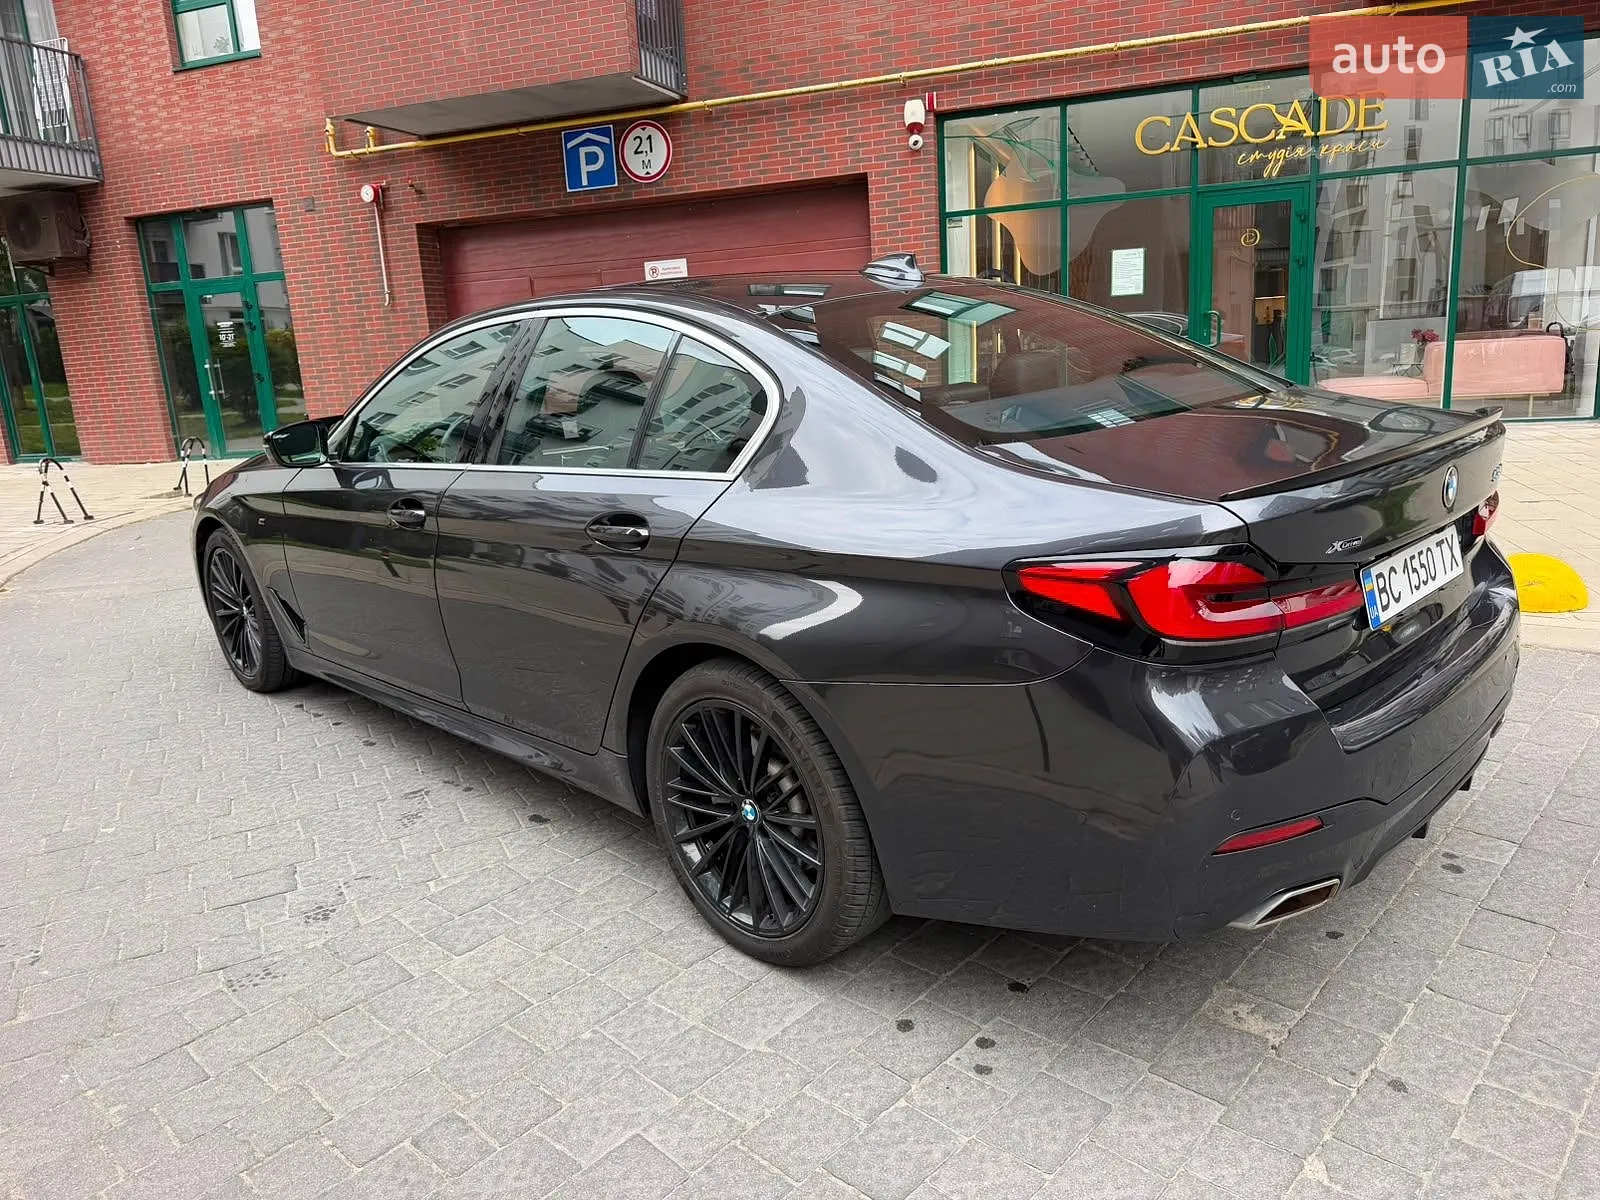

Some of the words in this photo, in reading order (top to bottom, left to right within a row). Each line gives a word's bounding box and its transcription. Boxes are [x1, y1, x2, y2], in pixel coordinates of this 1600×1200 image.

[1135, 90, 1388, 155] CASCADE
[579, 145, 605, 186] P
[633, 134, 653, 157] 2,1
[1375, 565, 1402, 613] BC
[1403, 546, 1437, 595] 1550
[1436, 534, 1459, 576] TX
[1369, 606, 1379, 618] UA
